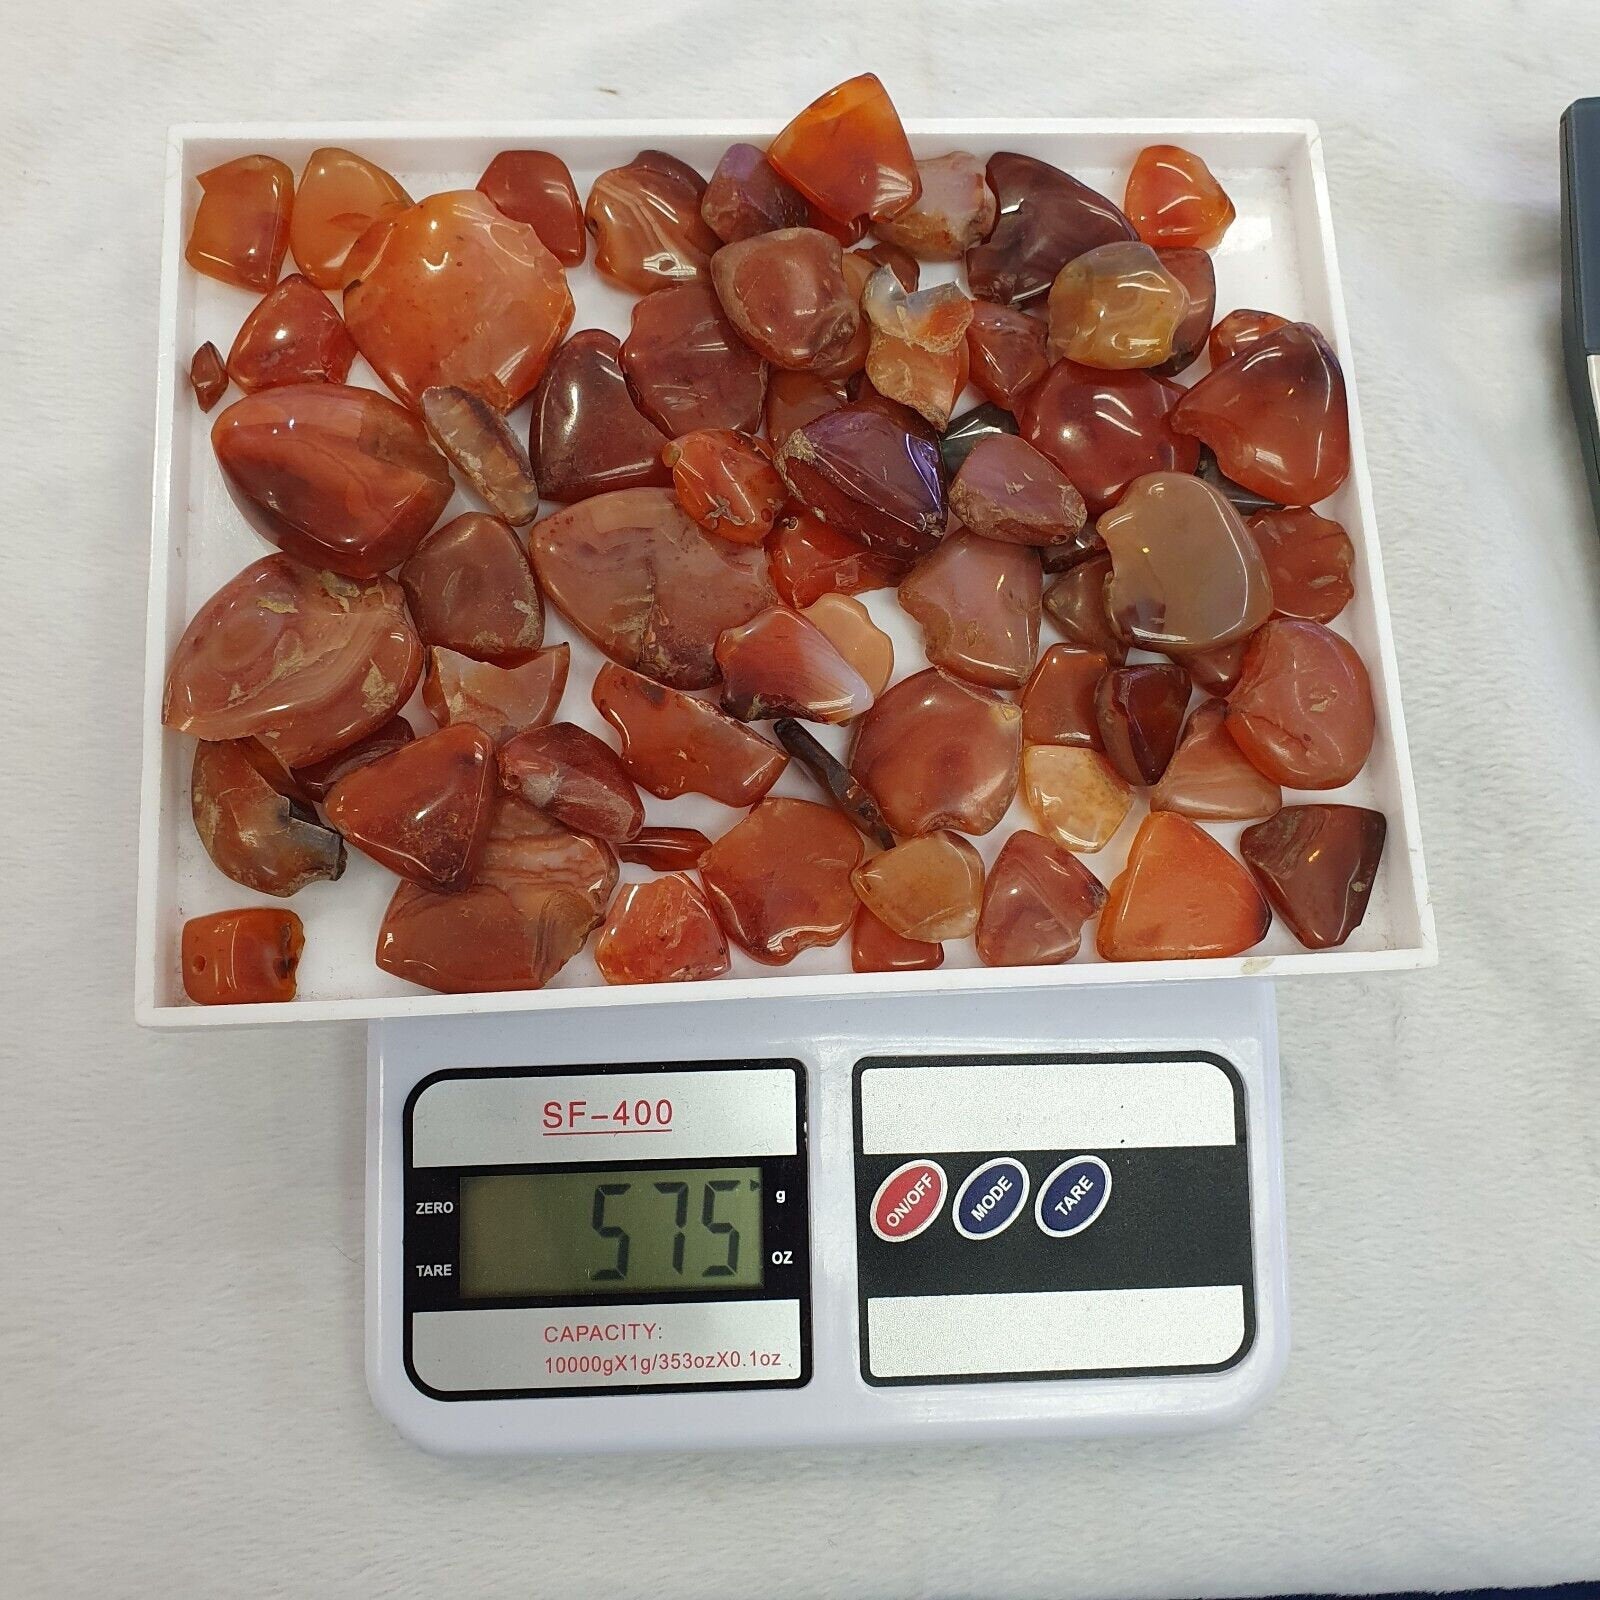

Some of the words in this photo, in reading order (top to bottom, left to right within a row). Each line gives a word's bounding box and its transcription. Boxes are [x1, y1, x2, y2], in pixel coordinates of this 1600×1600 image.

[542, 1099, 673, 1128] SF-400
[415, 1201, 454, 1215] ZERO
[775, 1189, 787, 1204] g
[885, 1172, 935, 1228] ON/OFF
[970, 1175, 1014, 1222] MODE
[1054, 1174, 1094, 1218] TARE
[590, 1179, 742, 1282] 575
[416, 1264, 452, 1277] TARE
[771, 1251, 793, 1265] OZ
[543, 1323, 663, 1343] CAPACITY:
[544, 1351, 781, 1376] 10000gX1g/353ozX0.1oz
